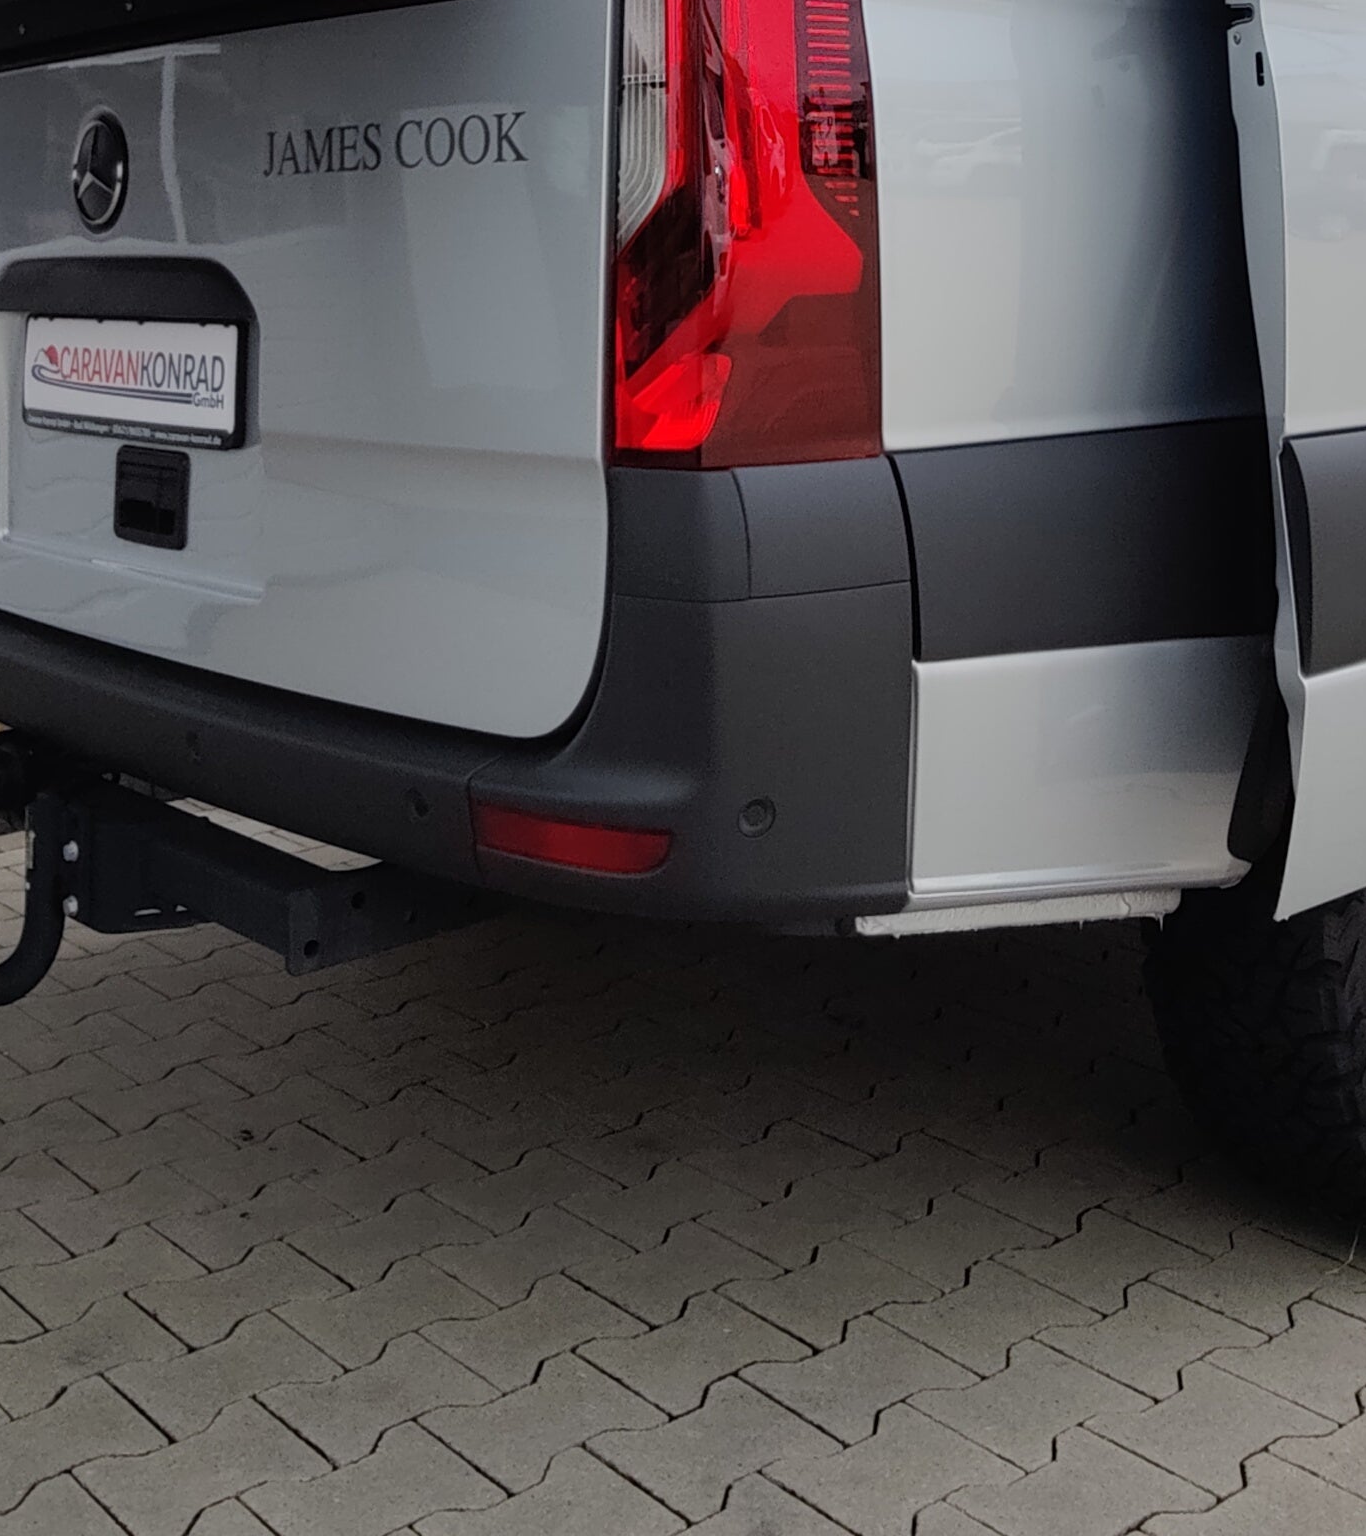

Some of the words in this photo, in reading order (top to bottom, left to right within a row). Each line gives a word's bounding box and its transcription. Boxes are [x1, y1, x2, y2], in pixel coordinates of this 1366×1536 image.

[263, 123, 382, 177] JAMES
[395, 111, 528, 169] COOK
[193, 392, 225, 410] GmbH
